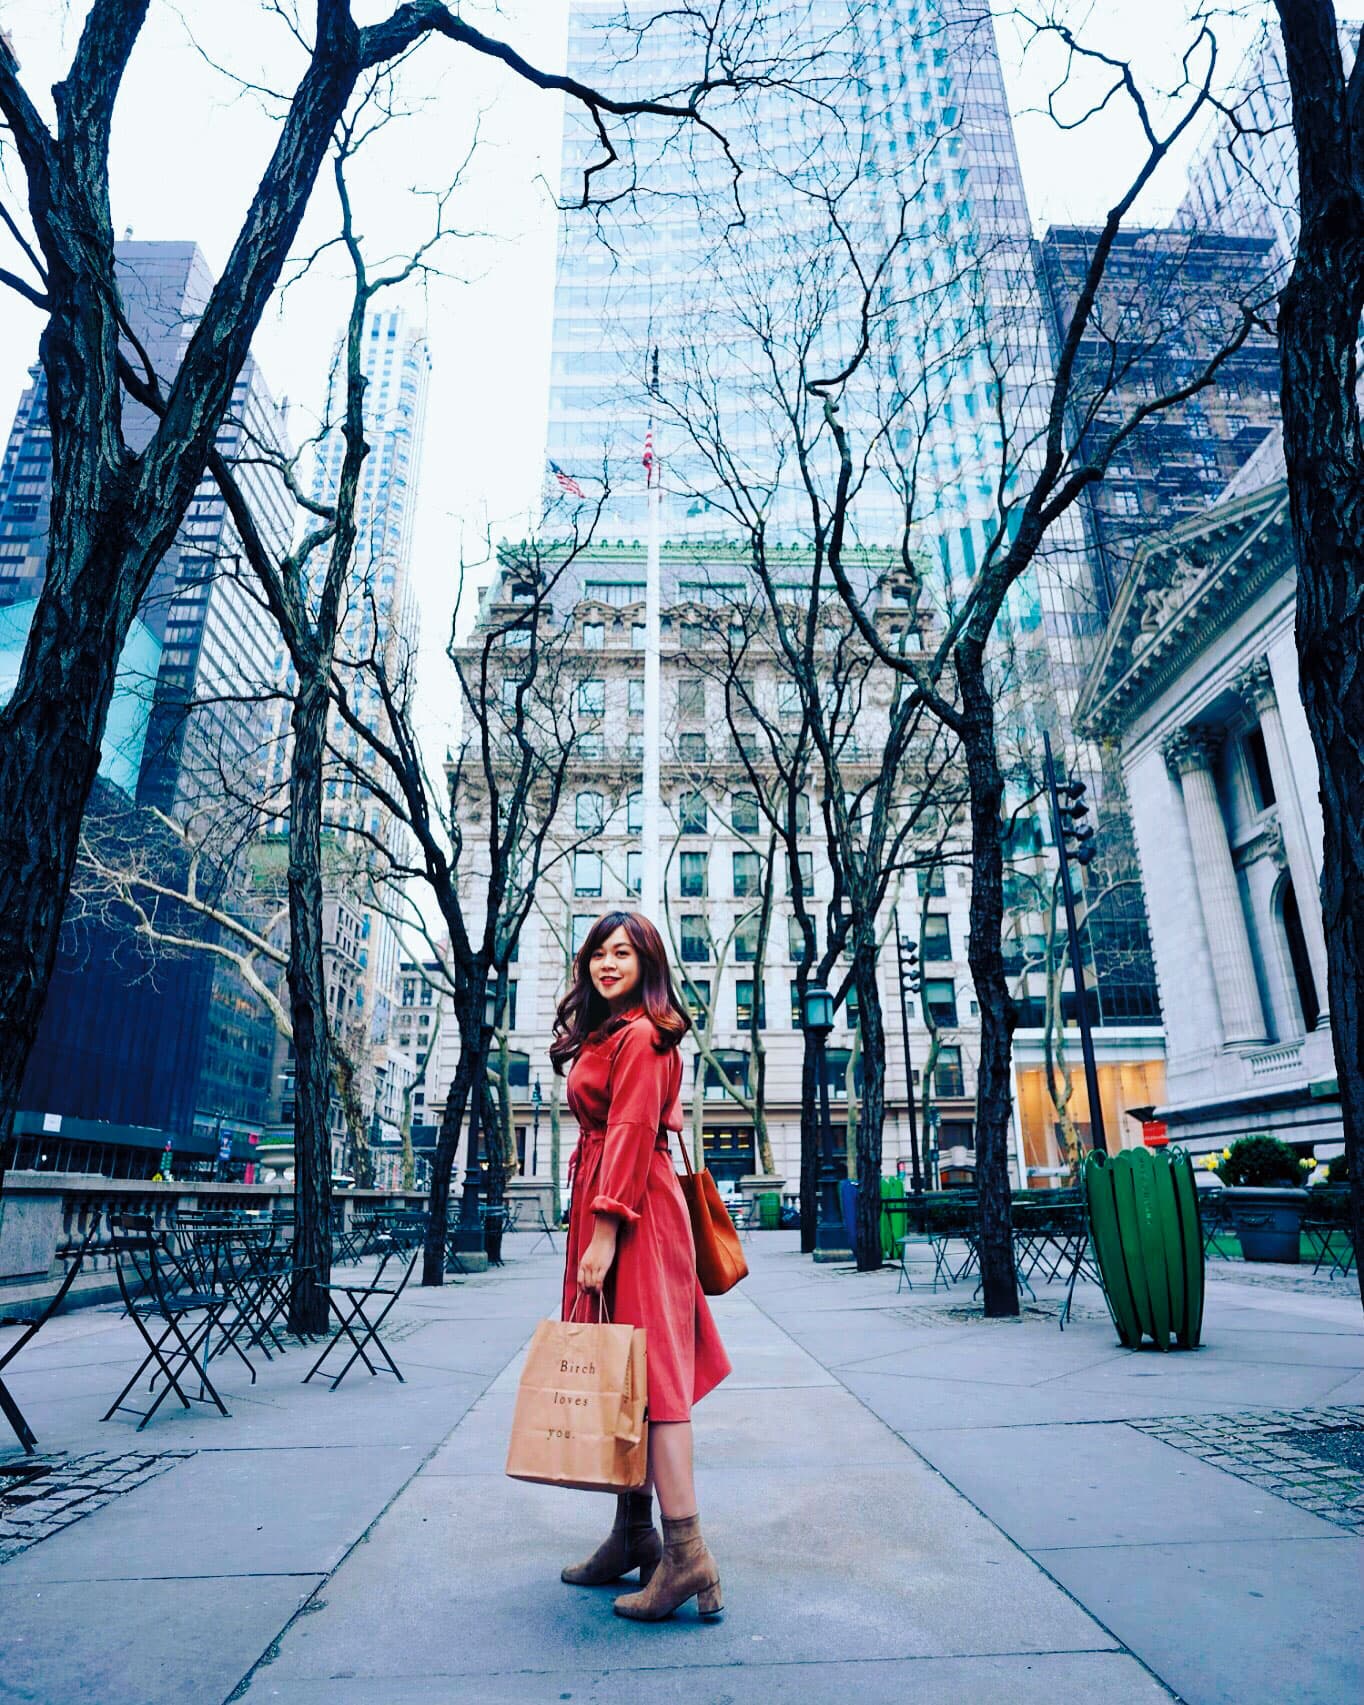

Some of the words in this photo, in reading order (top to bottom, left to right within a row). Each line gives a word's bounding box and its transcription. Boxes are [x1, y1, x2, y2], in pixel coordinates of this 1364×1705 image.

[560, 1360, 595, 1375] Birch
[553, 1391, 588, 1406] loves
[546, 1428, 575, 1440] you.
